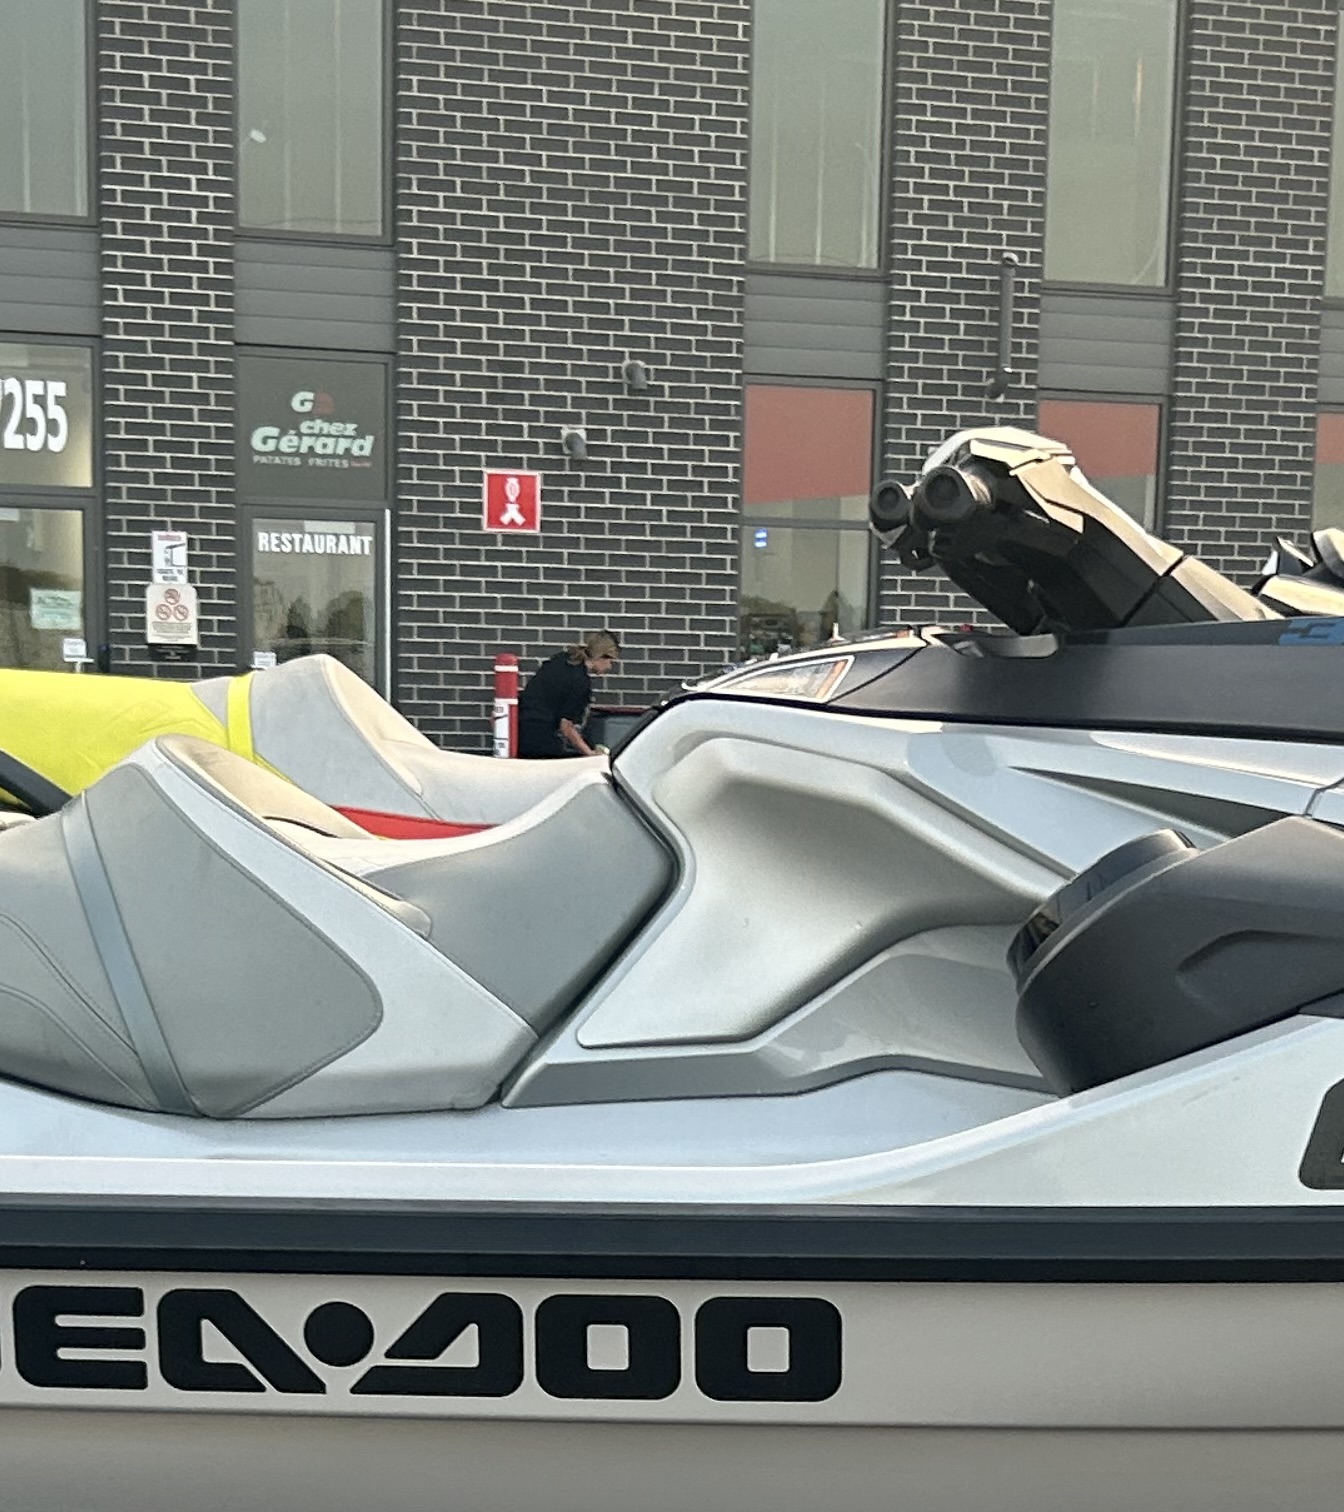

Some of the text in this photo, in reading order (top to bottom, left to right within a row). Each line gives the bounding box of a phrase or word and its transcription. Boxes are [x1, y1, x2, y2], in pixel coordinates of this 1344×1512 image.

[299, 418, 358, 436] chez
[251, 425, 375, 457] Gérard
[257, 531, 373, 555] RESTAURANT
